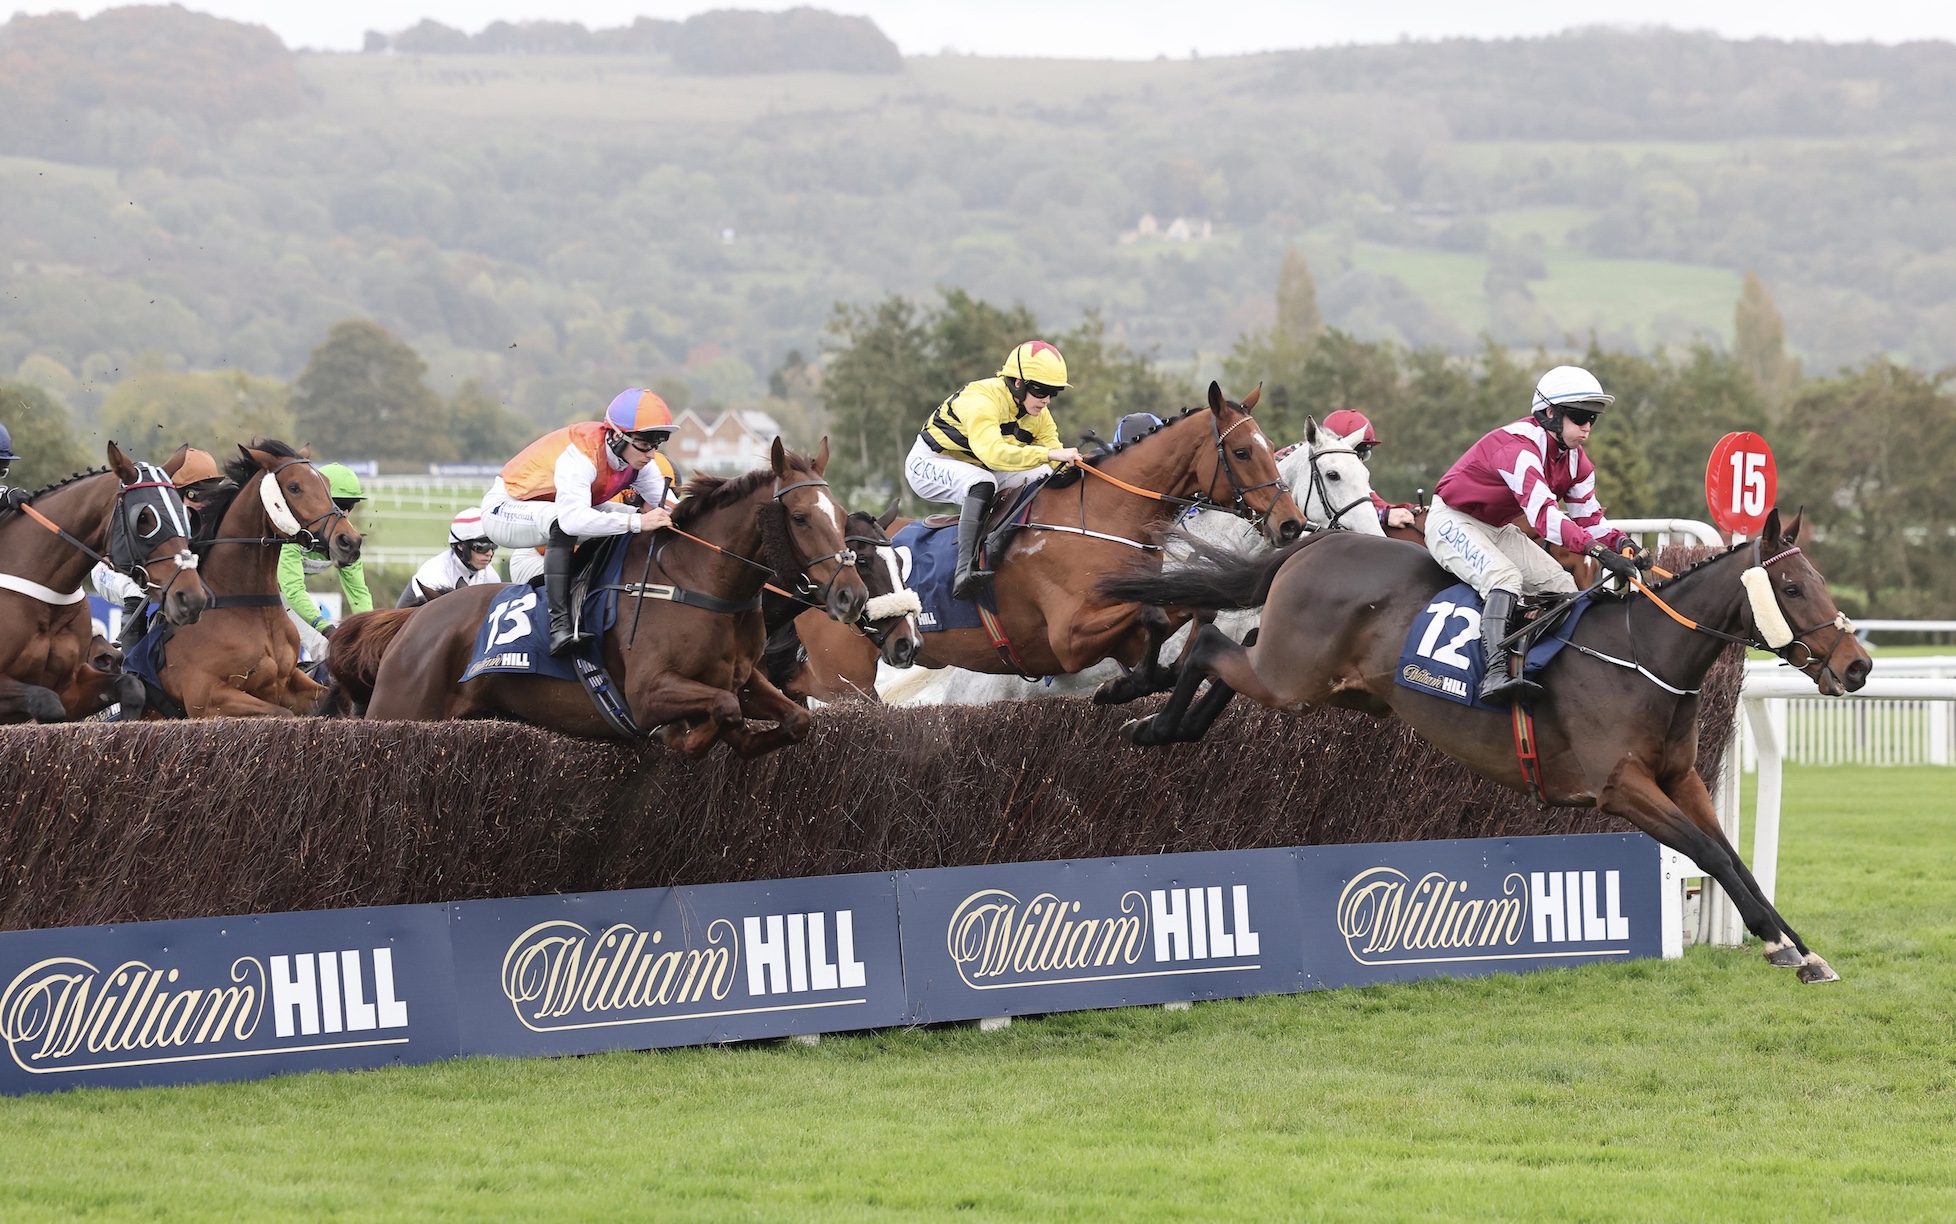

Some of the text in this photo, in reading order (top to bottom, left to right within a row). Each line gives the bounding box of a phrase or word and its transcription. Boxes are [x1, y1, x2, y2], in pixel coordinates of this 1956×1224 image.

[1730, 450, 1766, 516] 15
[1438, 519, 1491, 575] DORNAN
[484, 592, 537, 654] 13
[917, 612, 937, 625] HILL
[1416, 601, 1482, 670] 12
[502, 653, 530, 667] HILL
[1402, 664, 1467, 697] William HILL
[947, 885, 1260, 978] William HILL
[1337, 866, 1630, 954] William HILL
[501, 909, 867, 1019] William HILL
[0, 947, 409, 1061] William HILL
